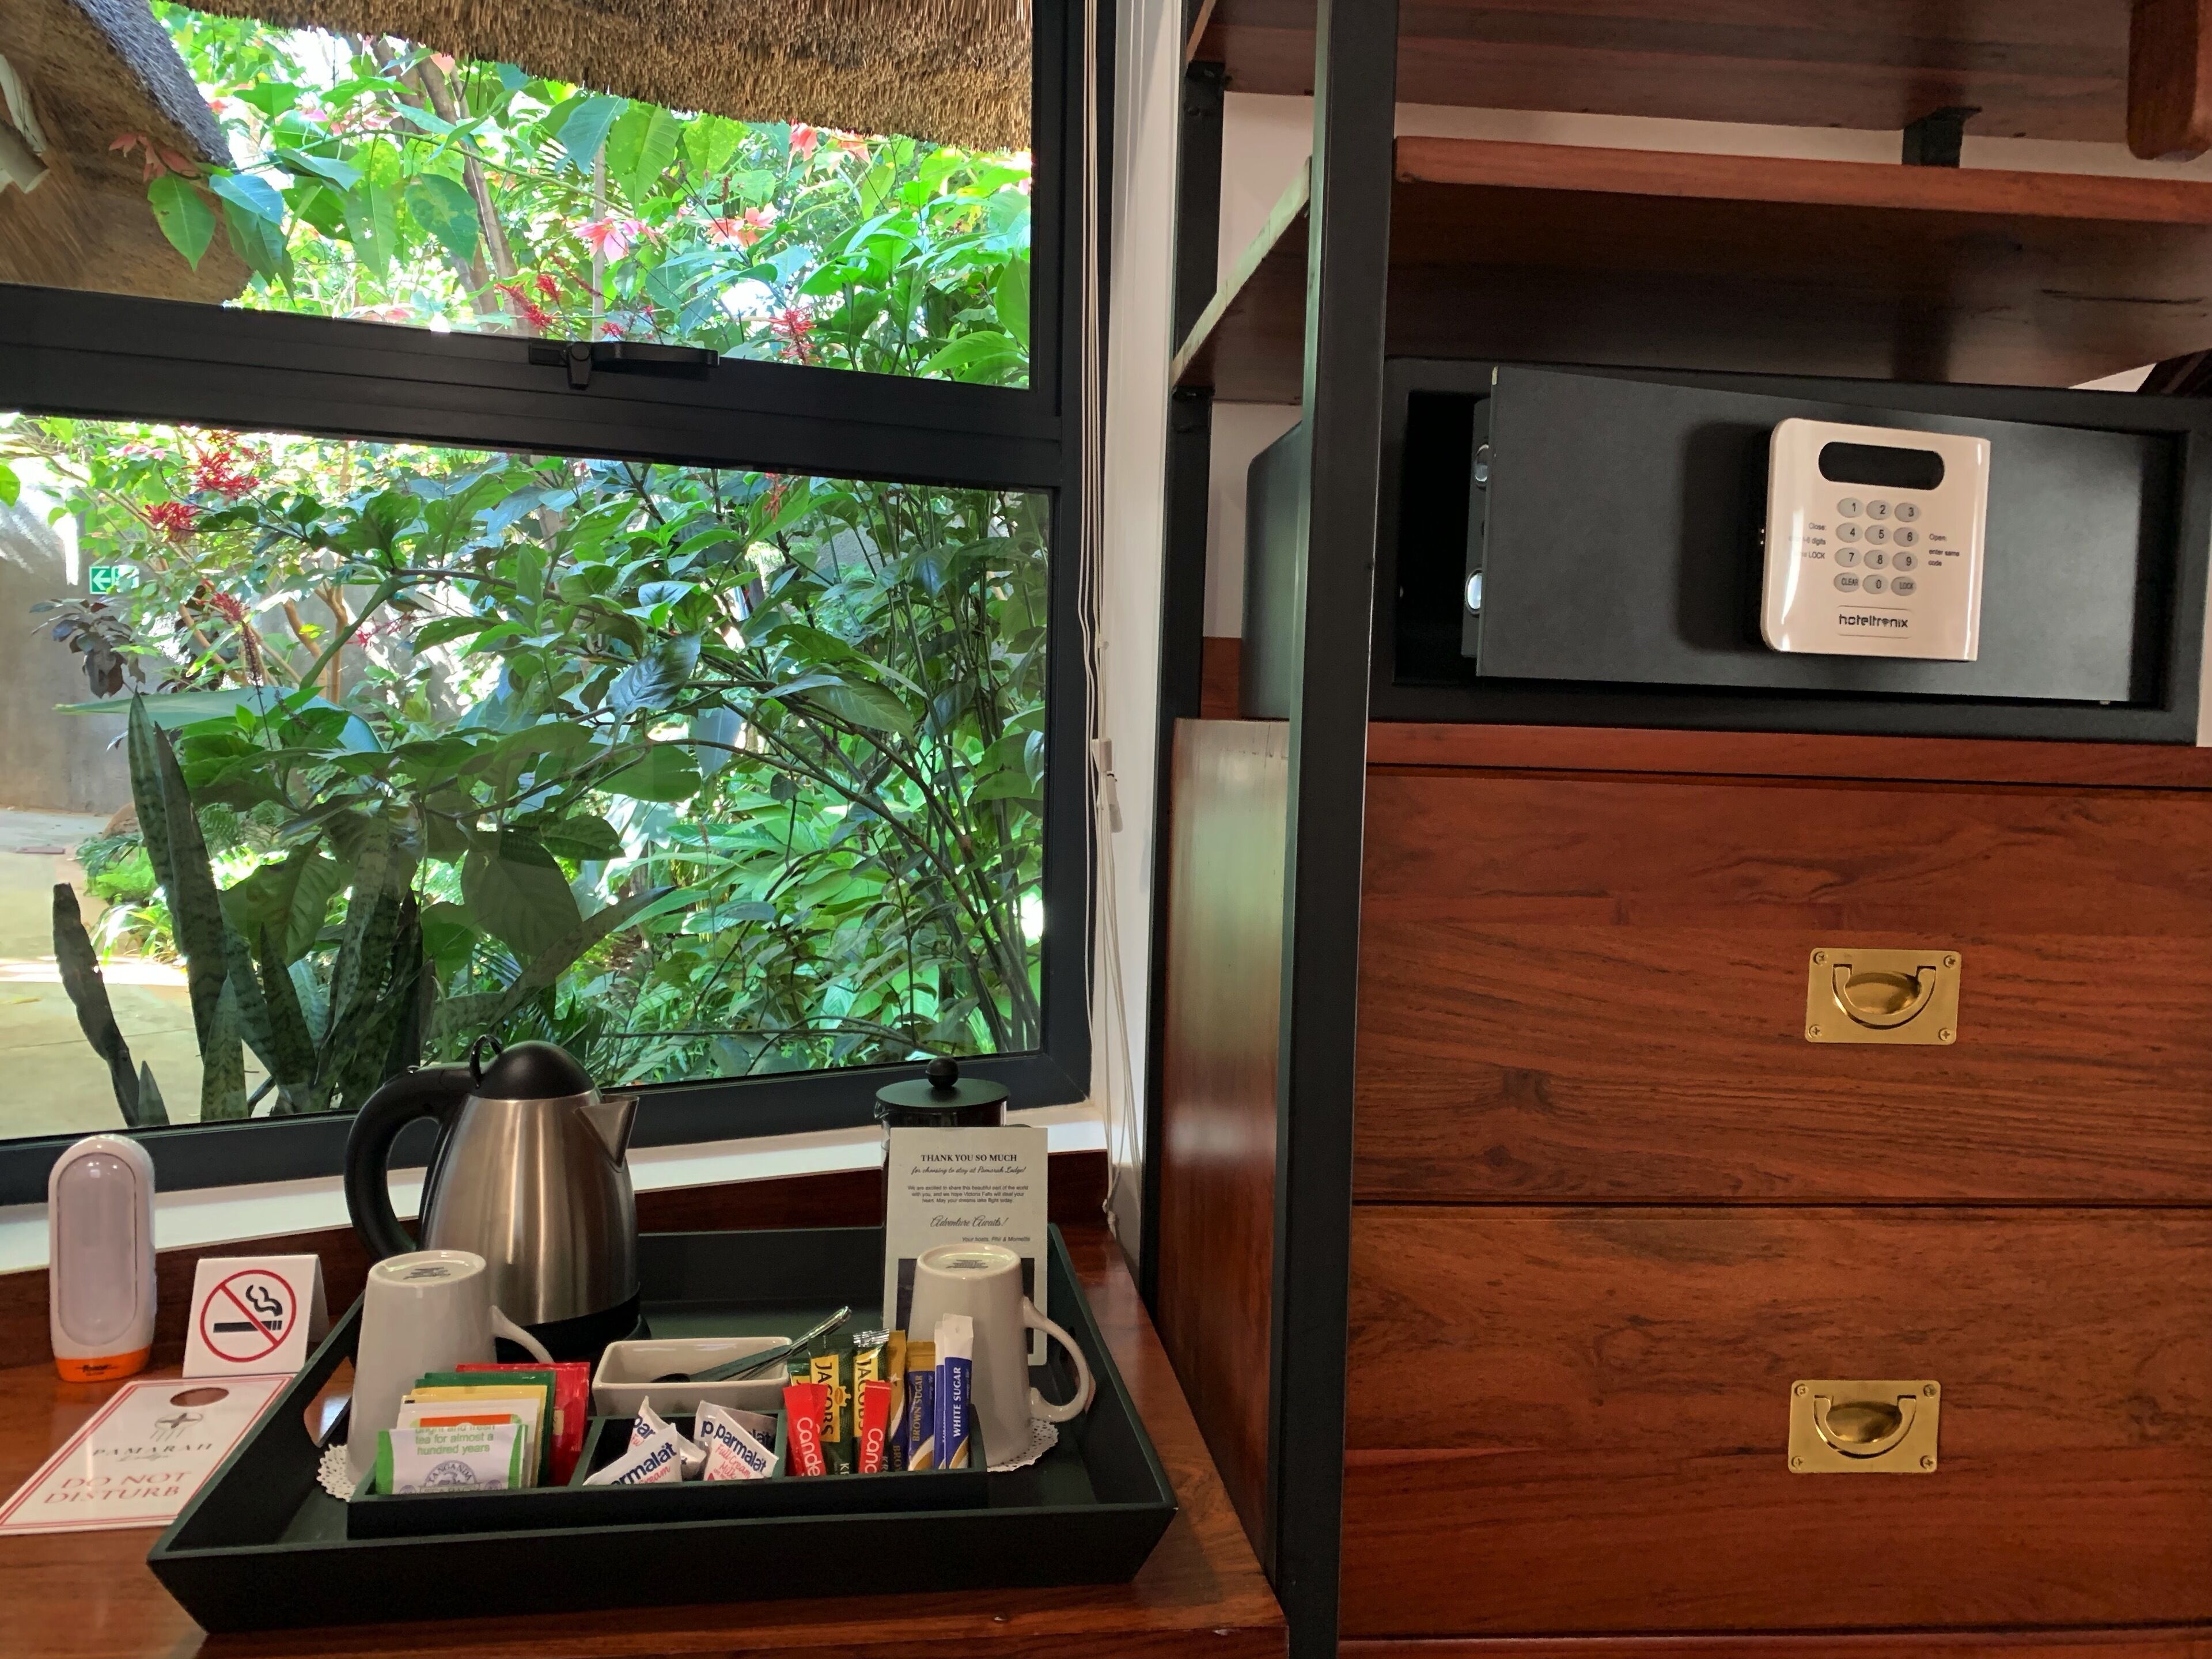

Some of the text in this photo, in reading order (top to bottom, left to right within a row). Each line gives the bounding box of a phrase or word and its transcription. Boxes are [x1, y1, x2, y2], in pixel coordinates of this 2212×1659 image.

[1851, 502, 1914, 517] 1 2 3
[1850, 527, 1913, 542] 4 5 6
[1849, 552, 1912, 566] 7 8 9
[1841, 578, 1914, 590] CLEAR 0 LOCK
[921, 1154, 1017, 1162] THANK YOU SO MUCH
[911, 1166, 921, 1175] for
[930, 1215, 1009, 1227] Adventure Awaits!
[912, 1374, 923, 1442] BROWN SUGAR
[953, 1366, 961, 1438] WHITE SUGAR
[415, 1435, 431, 1445] tea
[434, 1434, 447, 1444] for
[450, 1433, 484, 1442] almost
[93, 1444, 213, 1456] PAMARAH
[417, 1444, 490, 1456] hundred years
[61, 1471, 192, 1488] DO NOT
[428, 1463, 472, 1482] TANGANDA
[44, 1486, 180, 1503] DISTURB
